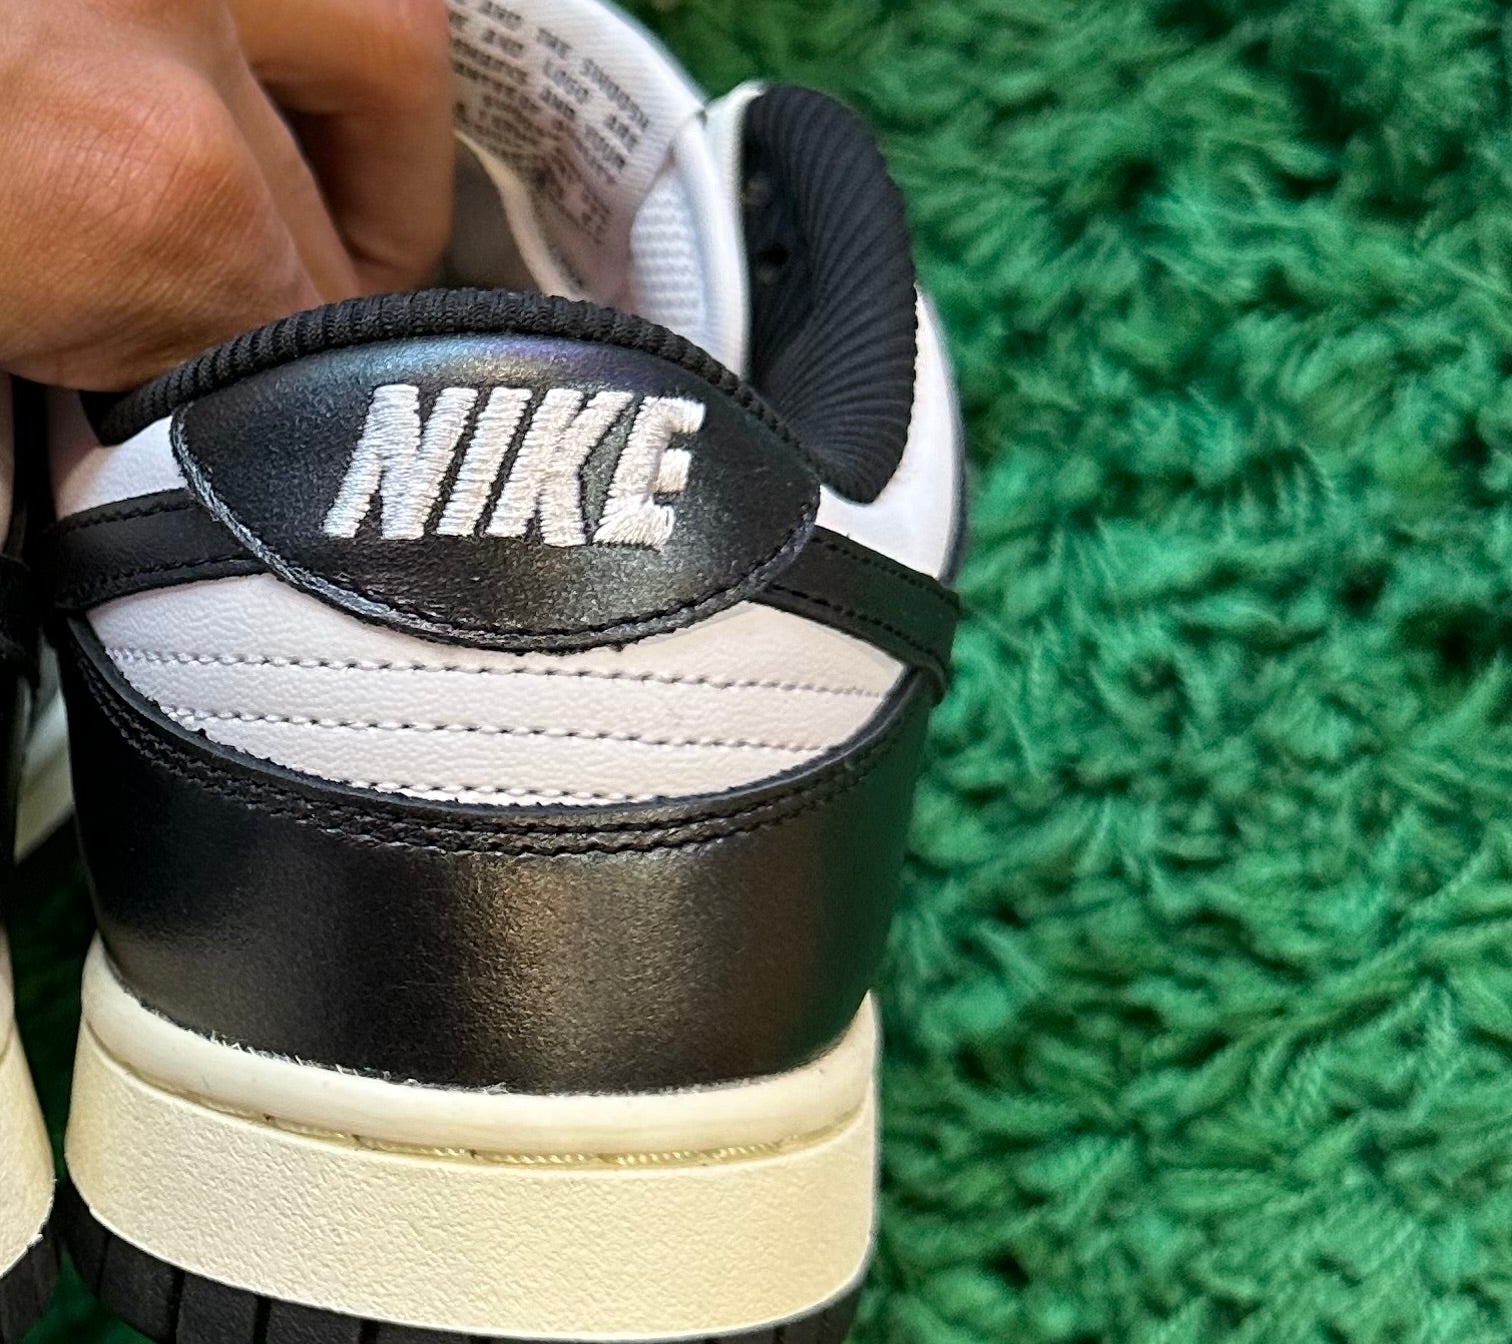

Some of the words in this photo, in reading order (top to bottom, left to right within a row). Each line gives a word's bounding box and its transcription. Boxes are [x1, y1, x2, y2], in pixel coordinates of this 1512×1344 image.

[478, 0, 523, 30] AND
[536, 25, 572, 58] THE
[580, 57, 650, 131] SWOOSH
[323, 384, 705, 552] NIKE
